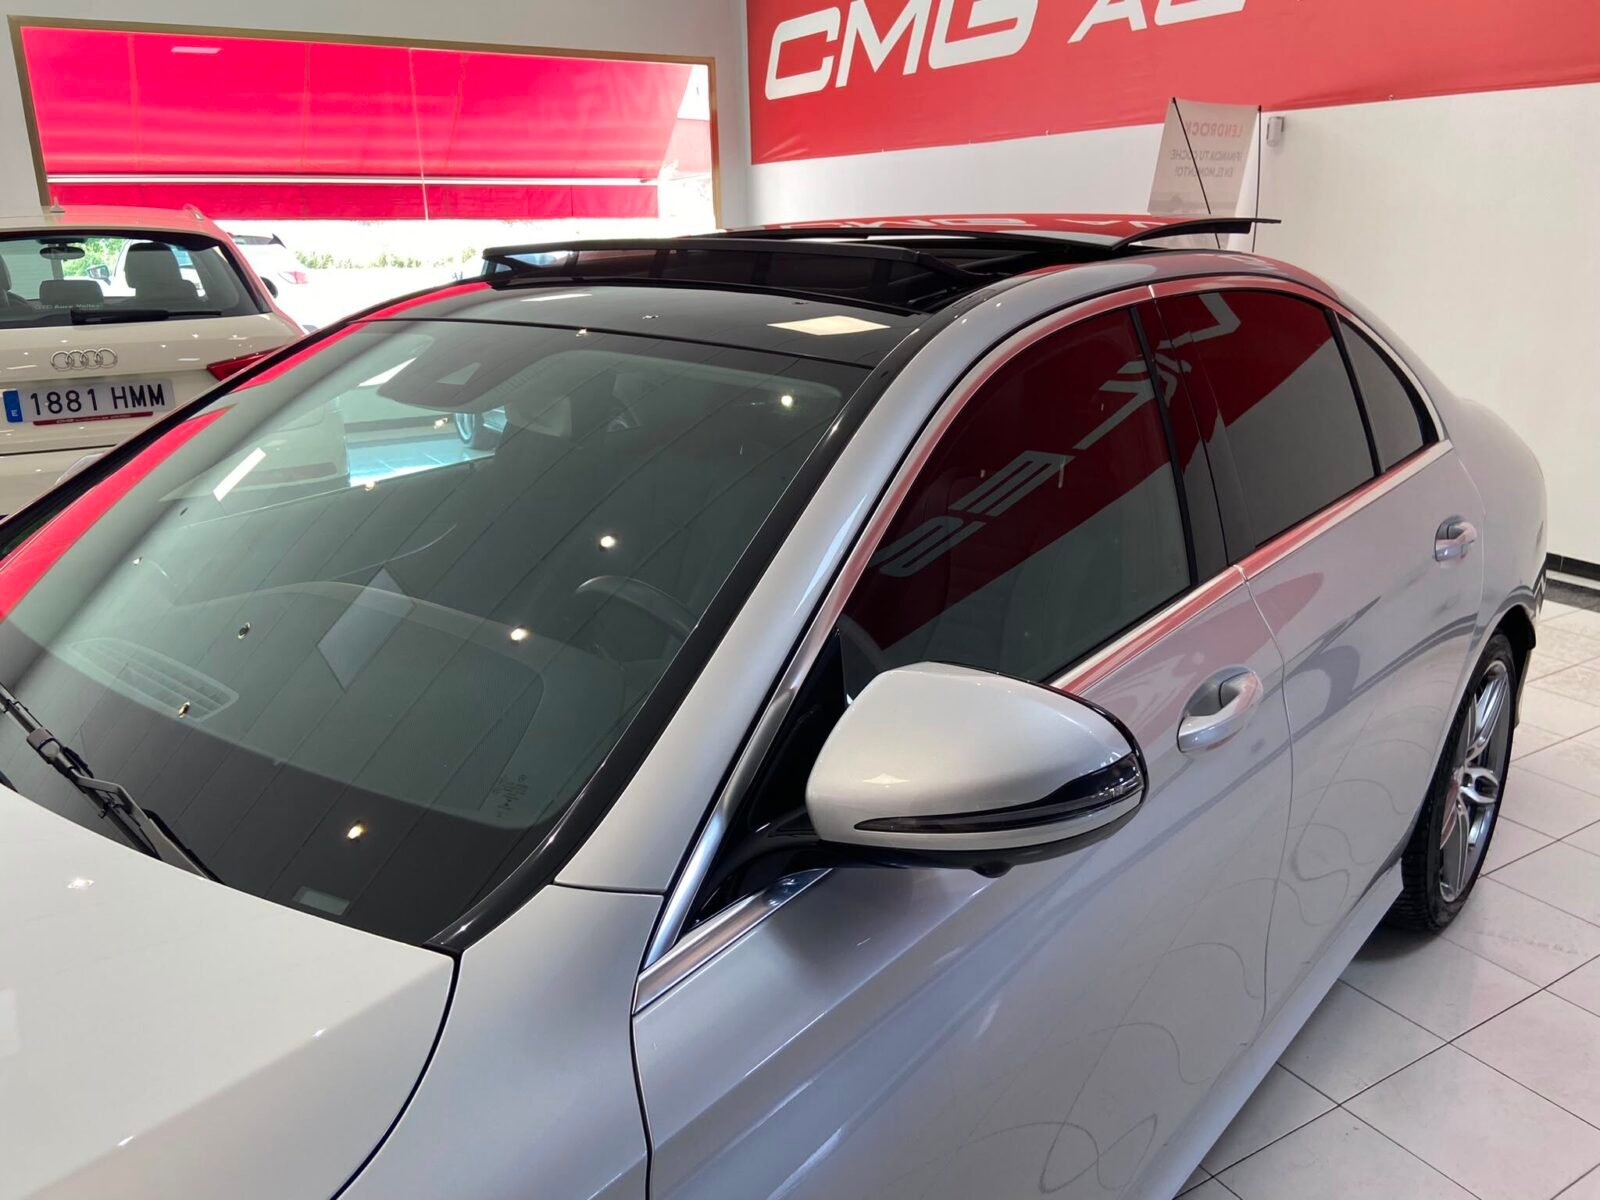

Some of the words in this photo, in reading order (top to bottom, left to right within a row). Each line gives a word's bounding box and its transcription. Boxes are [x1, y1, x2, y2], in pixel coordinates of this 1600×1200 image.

[765, 0, 1039, 100] CMG
[11, 409, 18, 417] E
[30, 388, 97, 415] 1881
[111, 383, 165, 409] HMM
